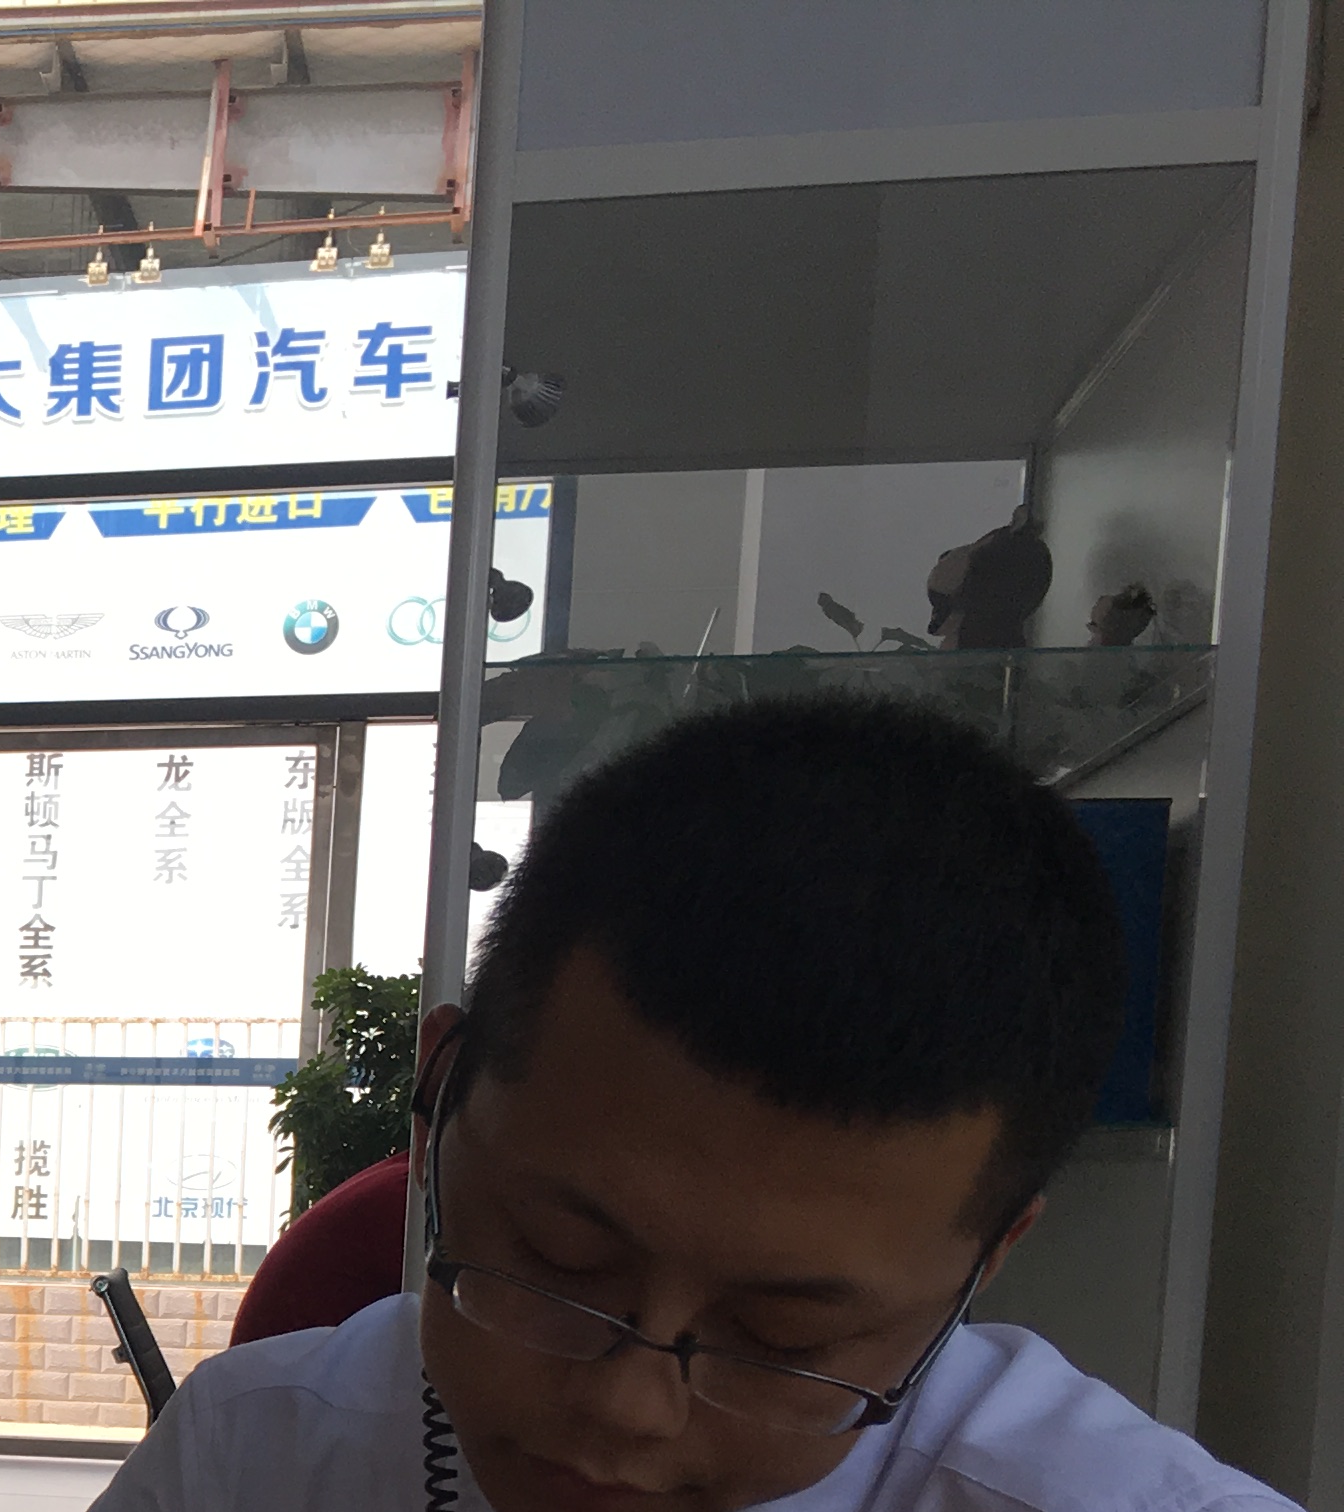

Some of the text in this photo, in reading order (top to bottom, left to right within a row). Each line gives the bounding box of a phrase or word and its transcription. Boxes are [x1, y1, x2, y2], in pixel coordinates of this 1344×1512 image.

[18, 752, 64, 989] 斯顿马丁全系
[153, 754, 194, 884] 龙全系
[152, 1197, 249, 1220] 北京现代
